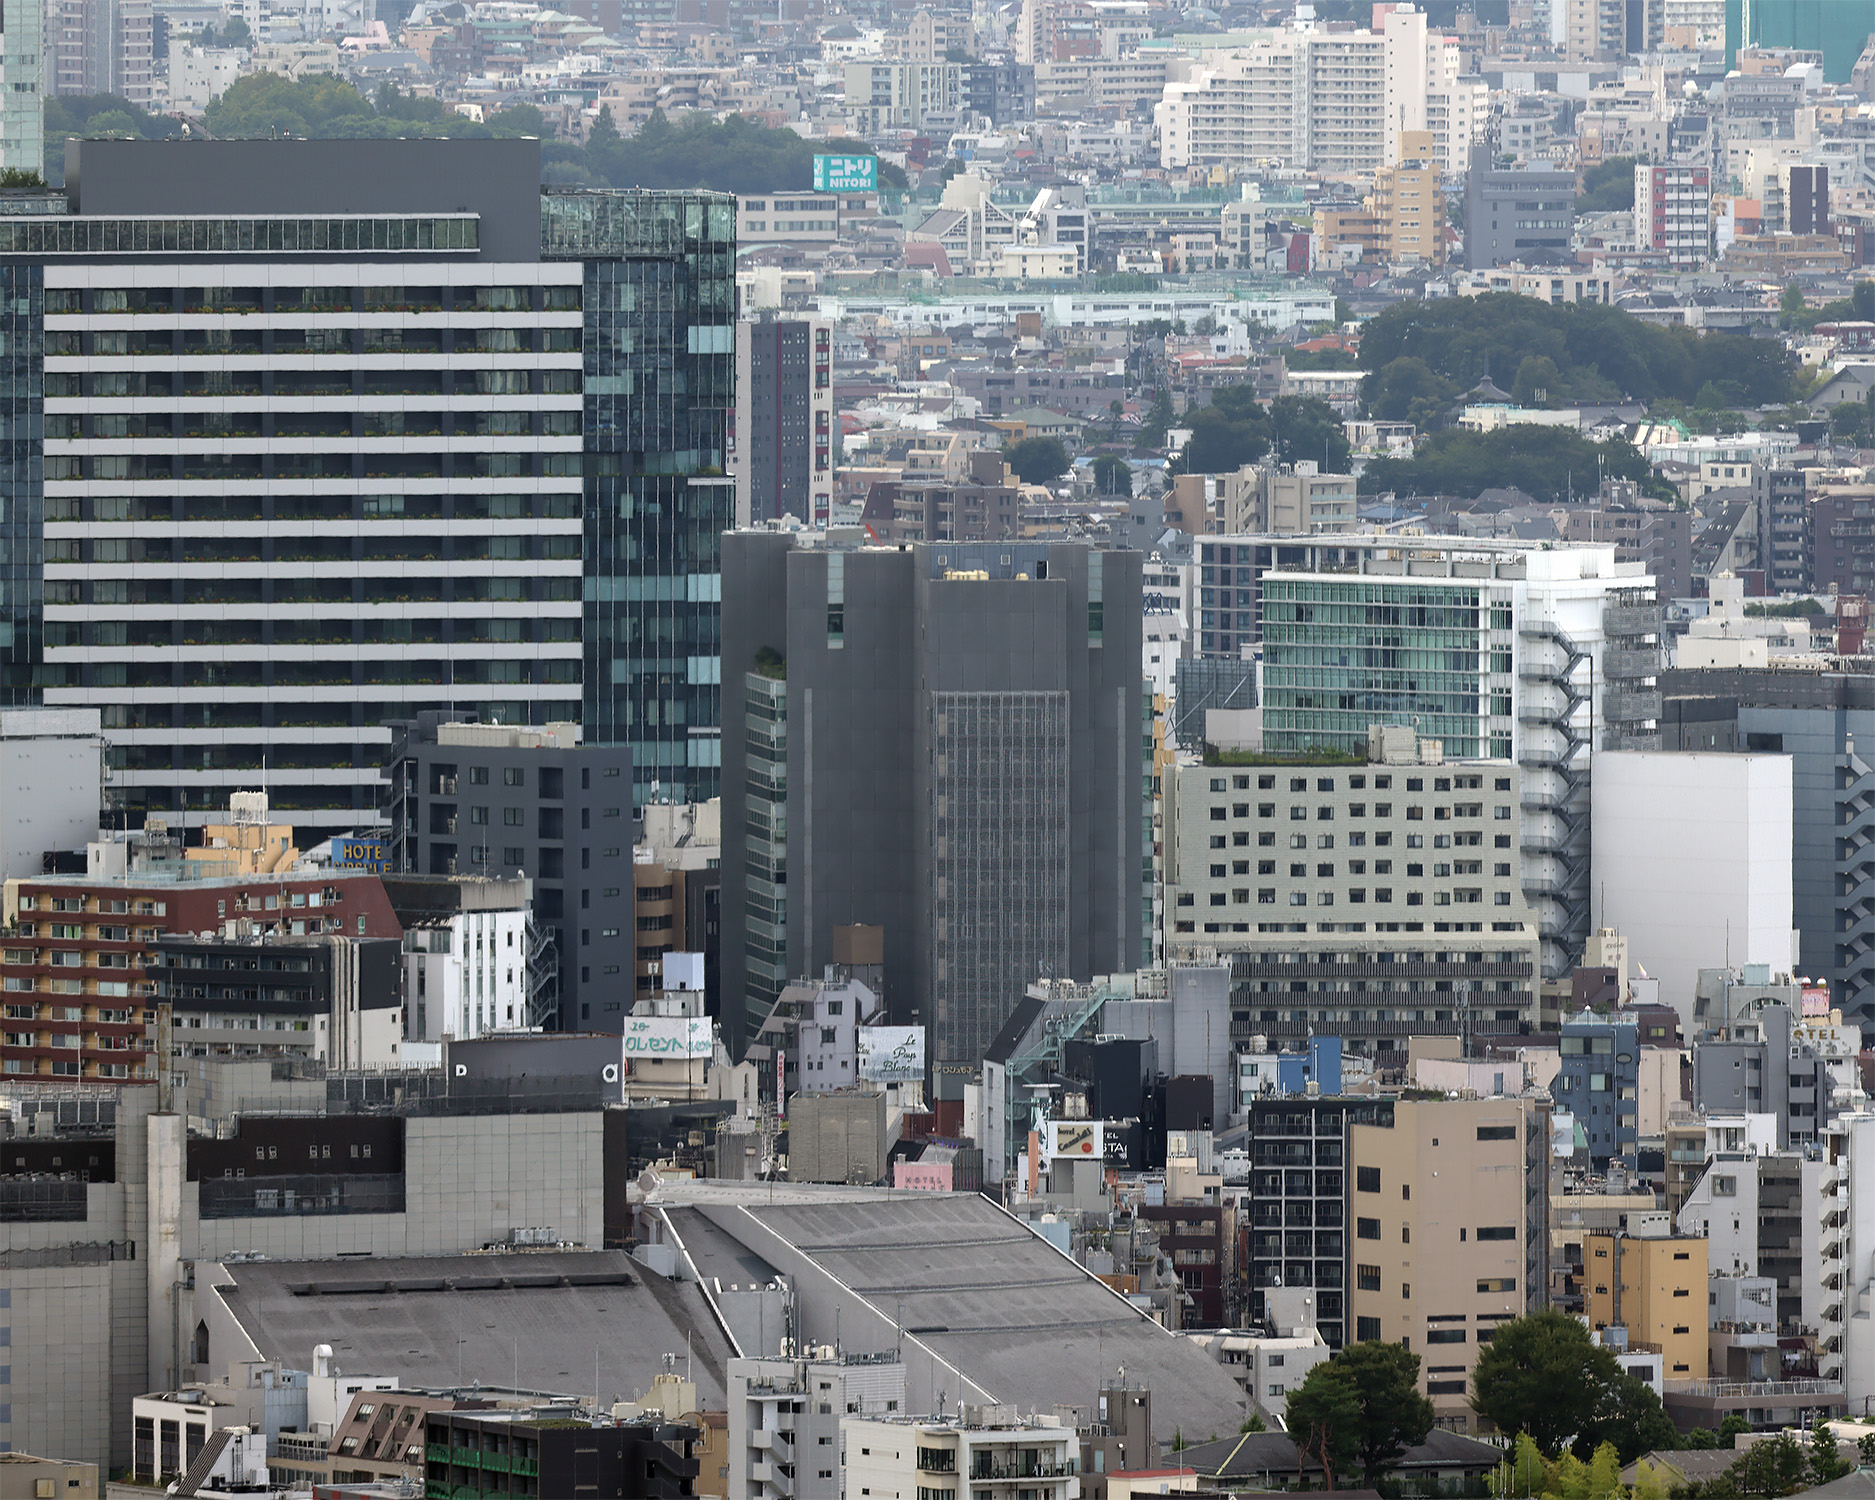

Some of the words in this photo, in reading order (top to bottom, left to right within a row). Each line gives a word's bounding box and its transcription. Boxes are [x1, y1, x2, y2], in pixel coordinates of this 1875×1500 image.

[829, 159, 871, 176] ニトリ
[830, 178, 871, 188] NITORI
[343, 844, 384, 860] HOTE
[1793, 1029, 1840, 1040] OTEL
[625, 1037, 684, 1052] クレセント
